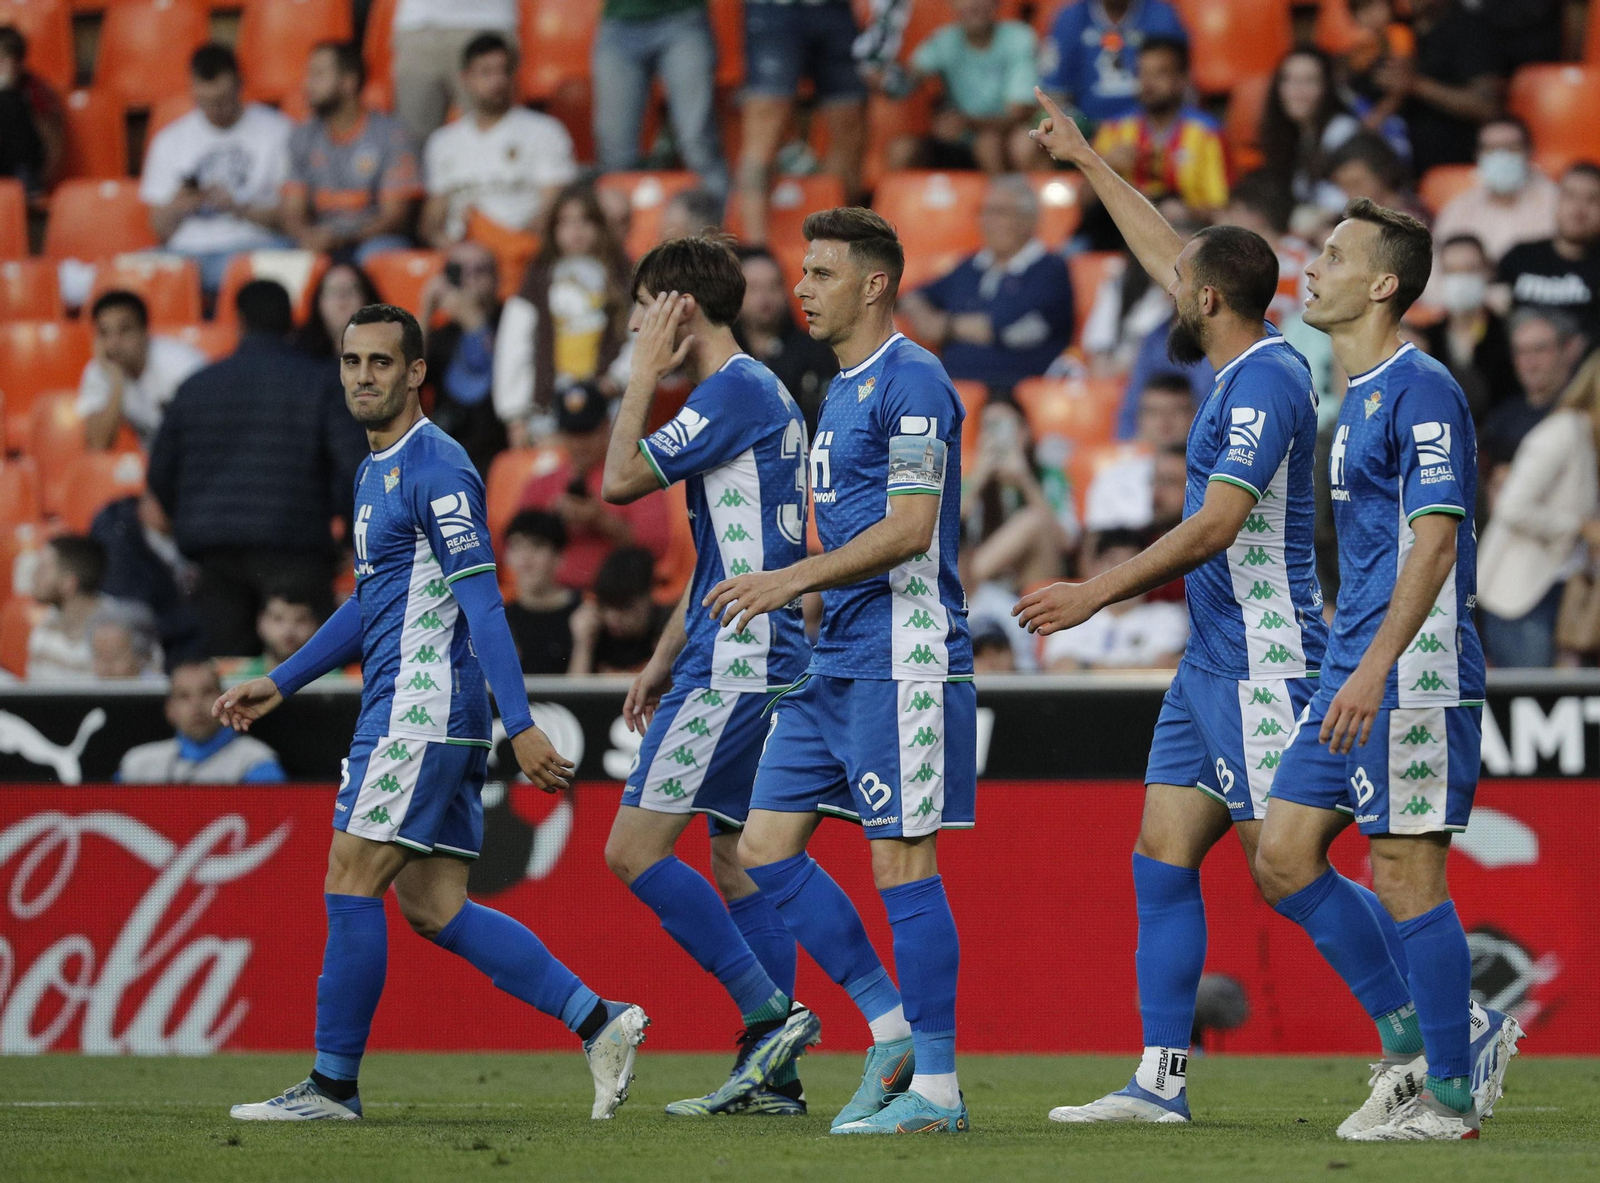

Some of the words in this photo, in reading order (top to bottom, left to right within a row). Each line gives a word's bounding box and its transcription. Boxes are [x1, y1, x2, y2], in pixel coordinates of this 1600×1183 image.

[653, 432, 682, 454] REALE
[813, 489, 837, 503] twork
[446, 532, 478, 549] REALE
[449, 541, 480, 555] SEGUROS
[1155, 1047, 1169, 1092] APEDESIGN
